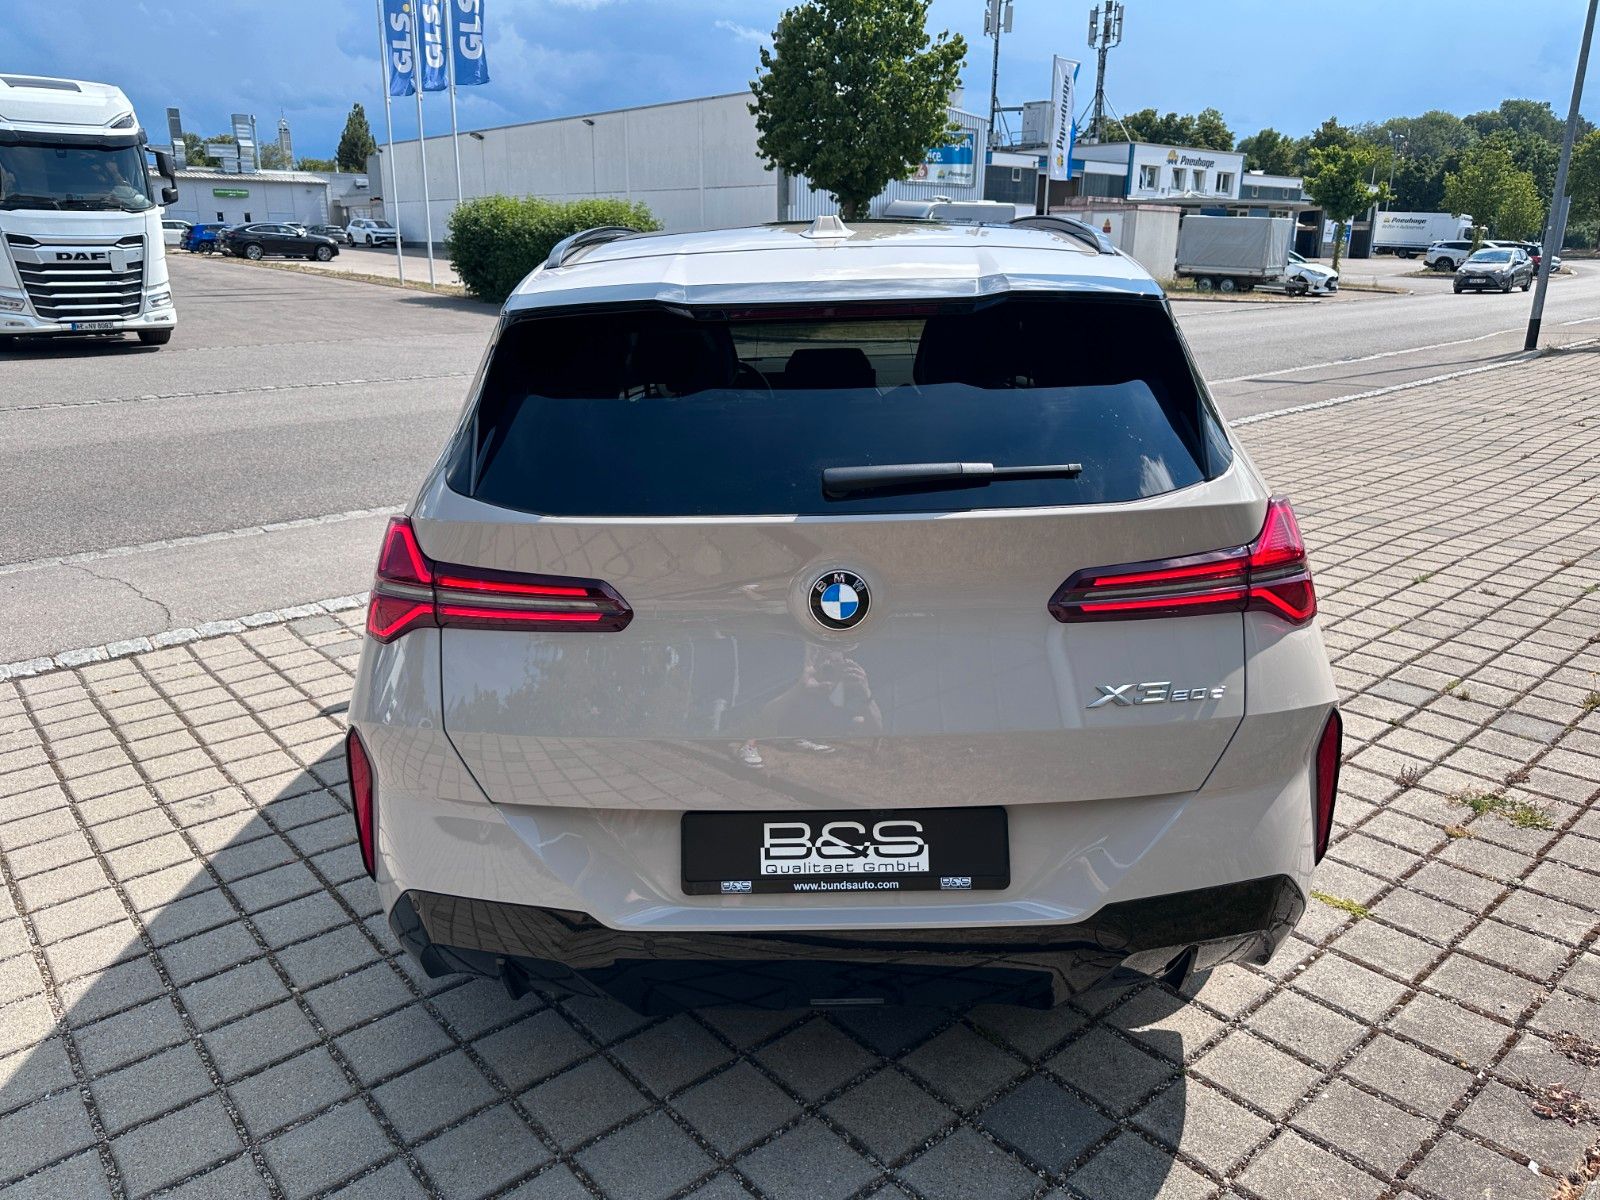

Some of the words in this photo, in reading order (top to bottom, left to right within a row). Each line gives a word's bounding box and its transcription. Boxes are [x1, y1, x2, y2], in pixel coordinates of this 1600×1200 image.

[1180, 155, 1216, 169] Pneuhage
[55, 252, 107, 261] DAF
[815, 573, 865, 592] BMW
[1083, 681, 1172, 709] X3
[763, 820, 925, 861] B&S
[765, 862, 855, 874] Qualitaet
[793, 880, 900, 891] www.bundsauto.com
